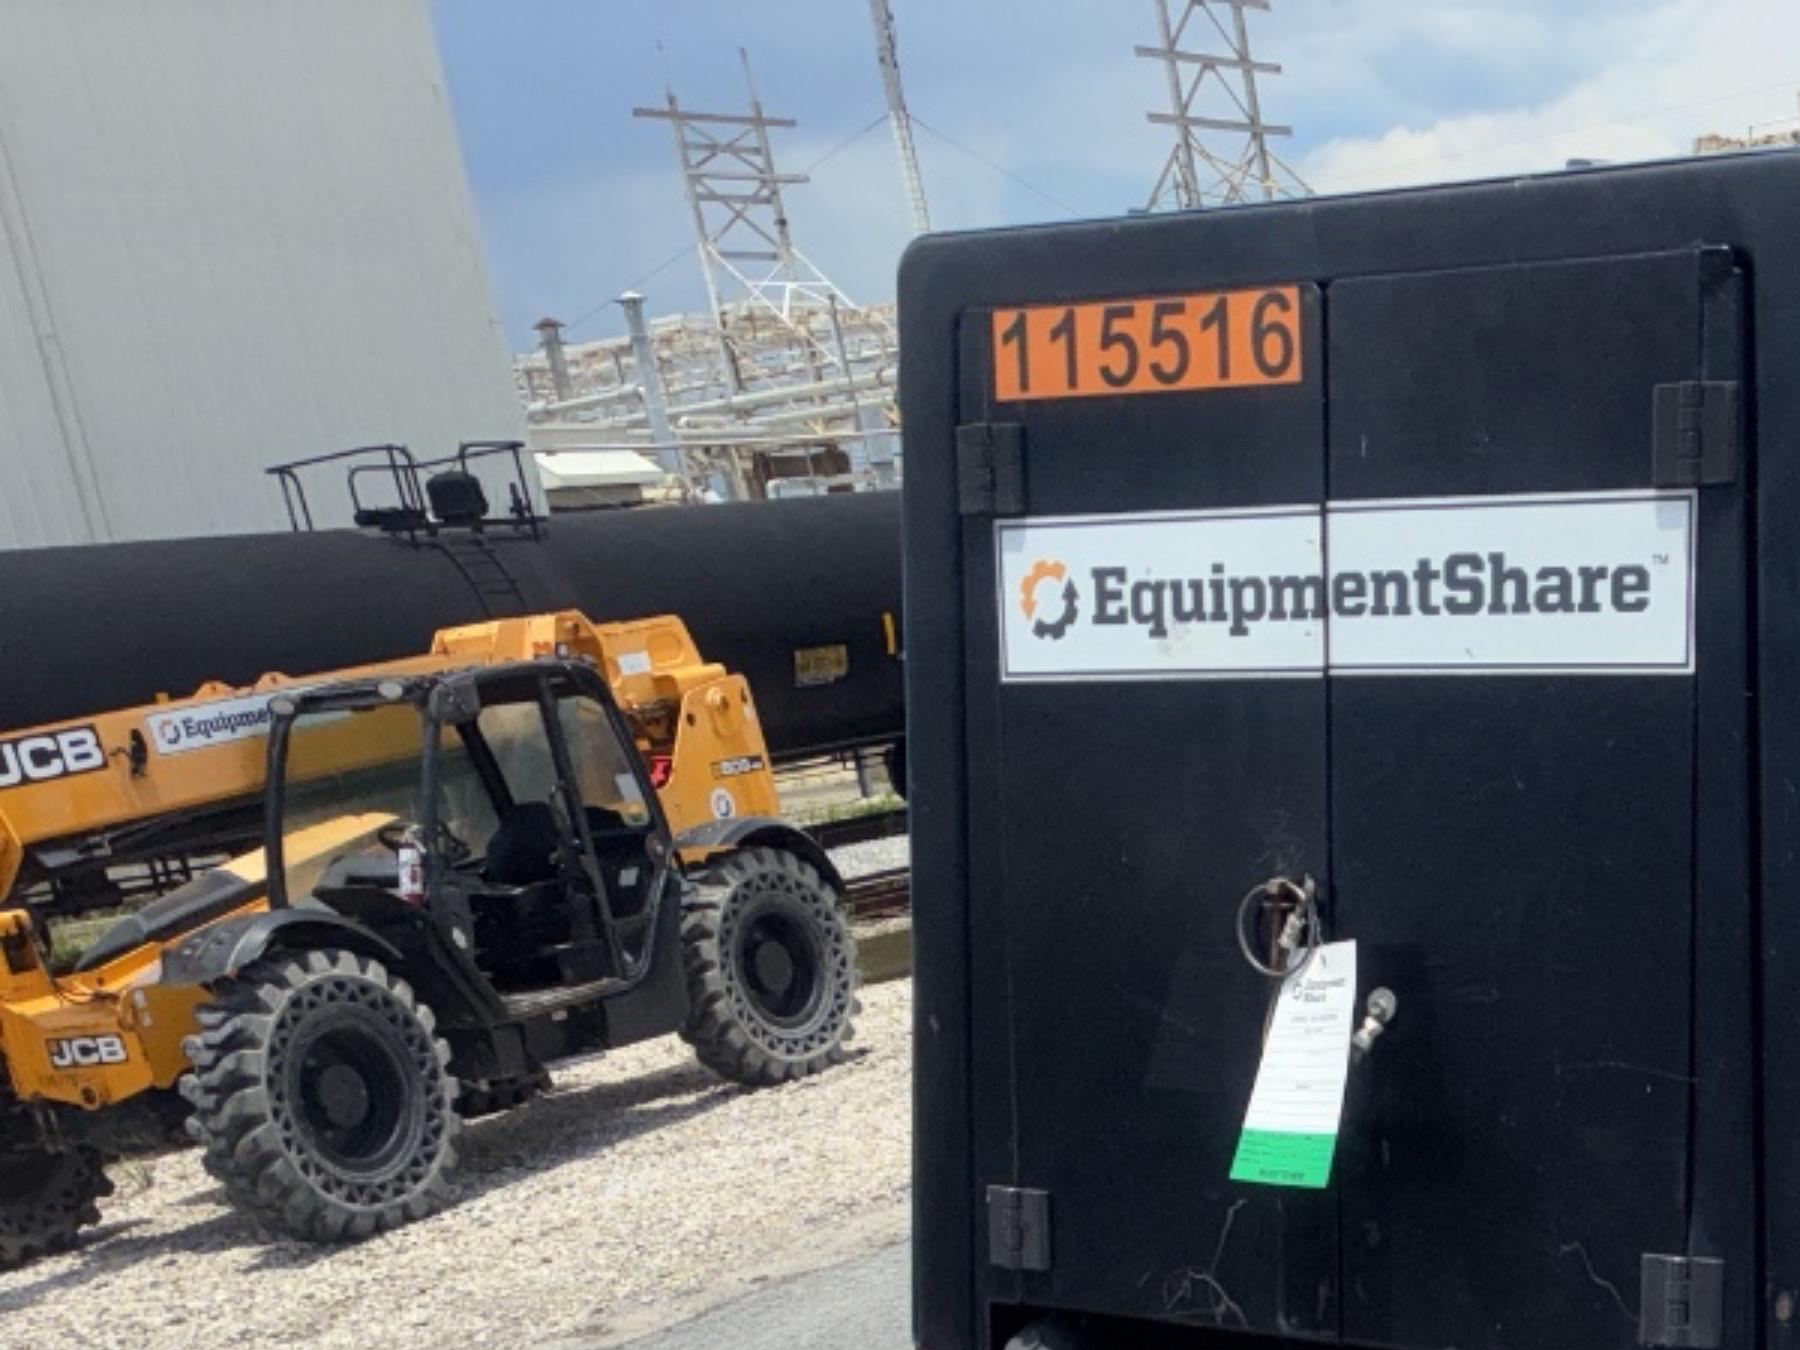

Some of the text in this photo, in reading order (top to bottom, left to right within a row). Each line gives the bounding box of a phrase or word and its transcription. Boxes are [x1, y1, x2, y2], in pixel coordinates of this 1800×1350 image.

[1001, 290, 1295, 392] 115516
[1090, 551, 1651, 638] EquipmentShare
[183, 706, 271, 739] Equipme
[0, 728, 104, 788] JCB
[53, 1036, 127, 1067] JCB
